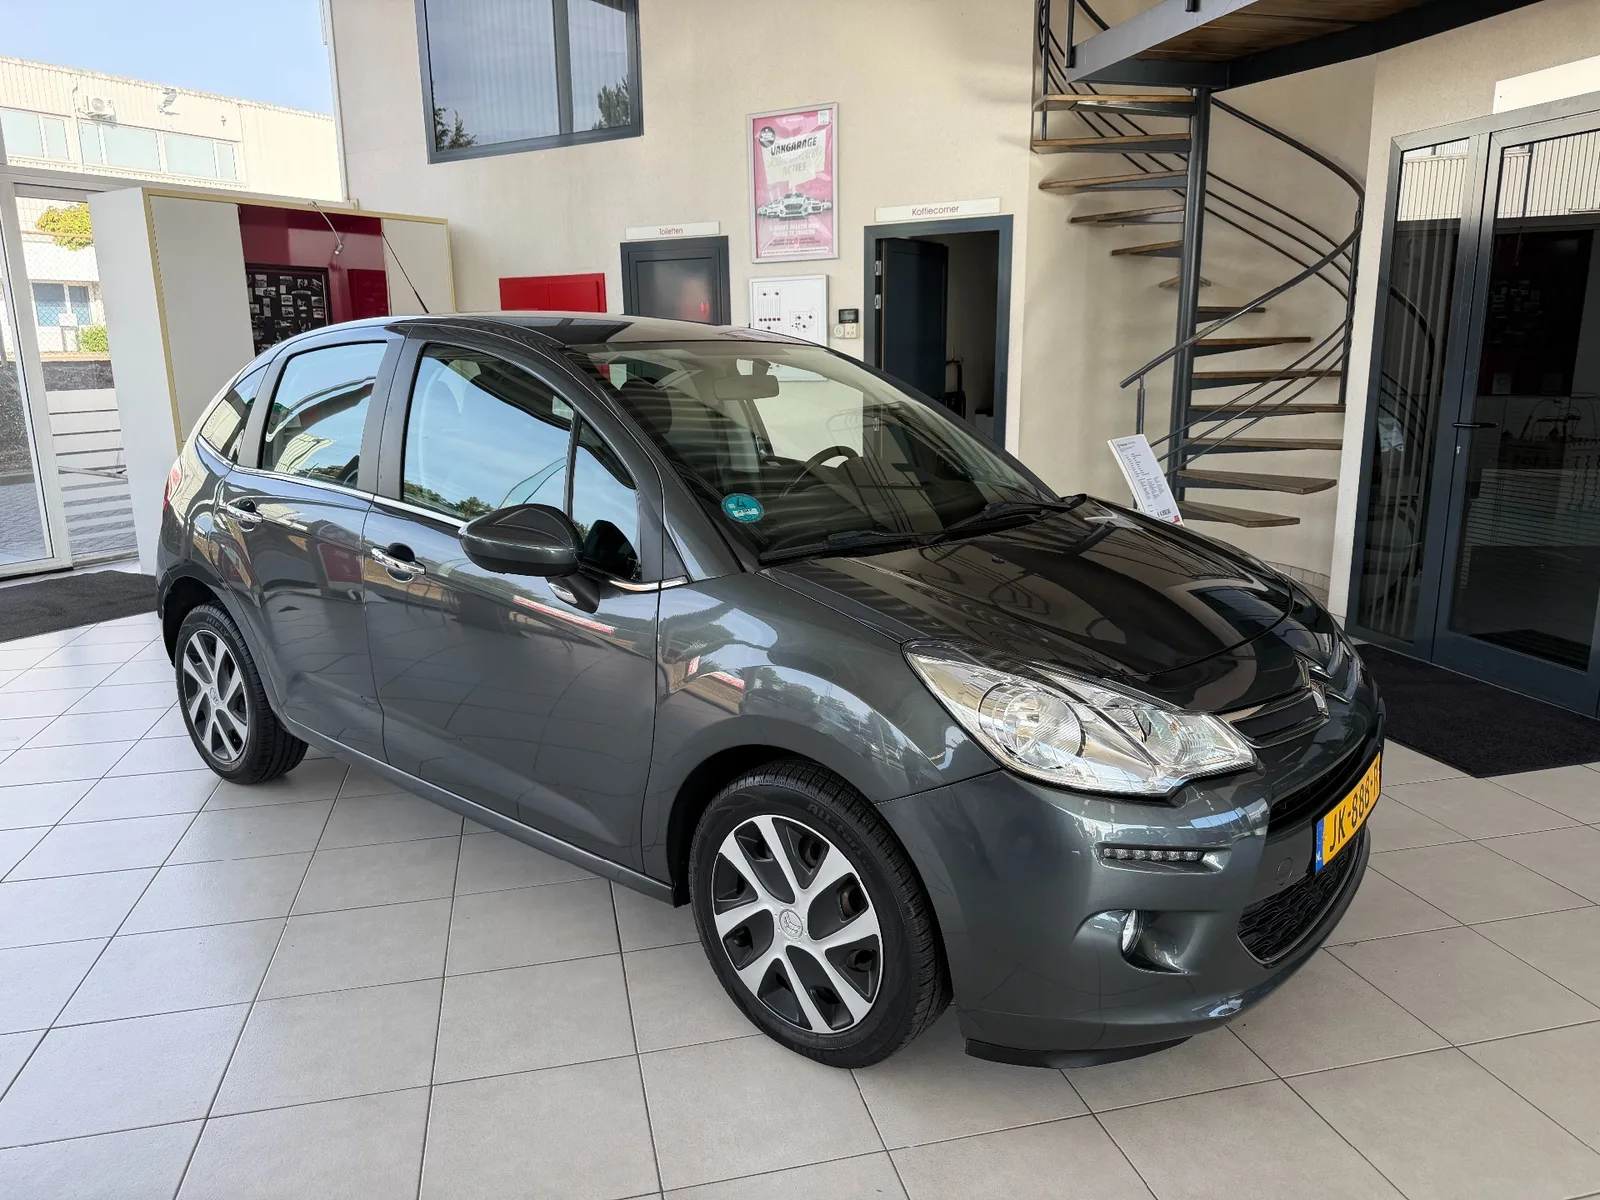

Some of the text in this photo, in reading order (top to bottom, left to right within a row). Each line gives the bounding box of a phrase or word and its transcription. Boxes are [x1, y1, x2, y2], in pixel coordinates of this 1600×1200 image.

[911, 205, 960, 216] Koffiecorner
[659, 227, 684, 236] Toiletten
[206, 615, 229, 637] HIFLY
